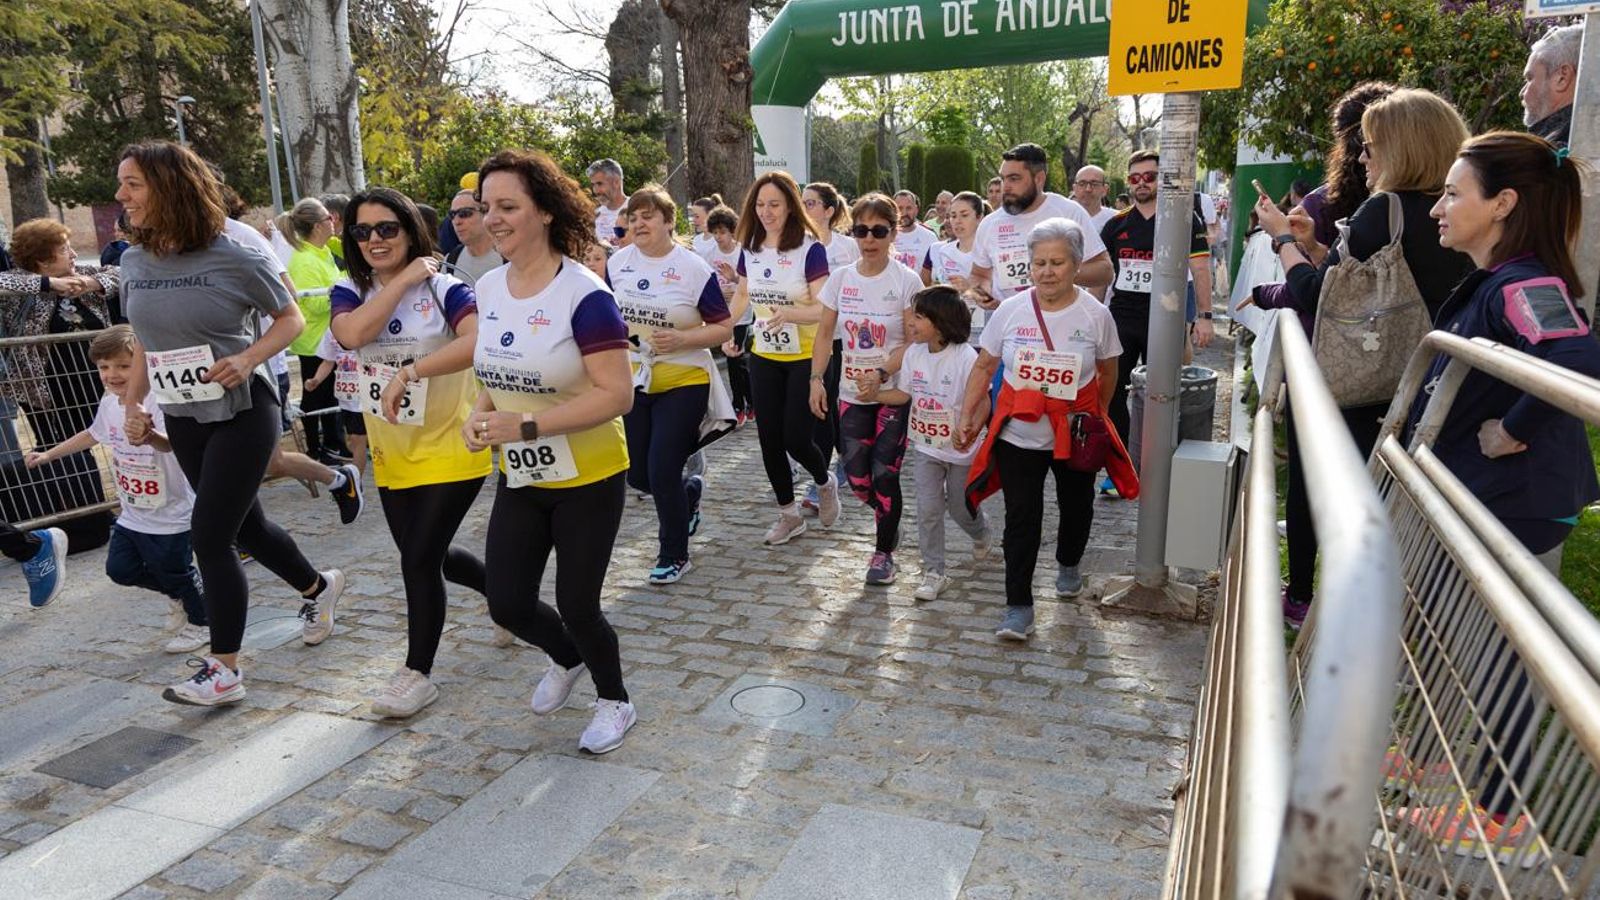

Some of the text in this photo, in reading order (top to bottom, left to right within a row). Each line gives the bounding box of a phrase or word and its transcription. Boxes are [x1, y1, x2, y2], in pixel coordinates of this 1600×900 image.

[1167, 0, 1190, 24] DE
[831, 4, 925, 47] JUNTA
[941, 0, 979, 38] DE
[1126, 38, 1223, 74] CAMIONES
[754, 158, 787, 167] ndalucía
[1006, 262, 1031, 277] 32
[1126, 270, 1152, 283] 319
[623, 315, 675, 329] PÓSTOLES
[652, 311, 667, 321] DE
[762, 331, 790, 344] 913
[475, 369, 502, 381] ANTA
[523, 377, 542, 387] DE
[1018, 364, 1074, 386] 5356
[335, 381, 360, 394] 523
[369, 382, 411, 409] 85
[911, 417, 950, 437] 5353
[507, 445, 556, 470] 908
